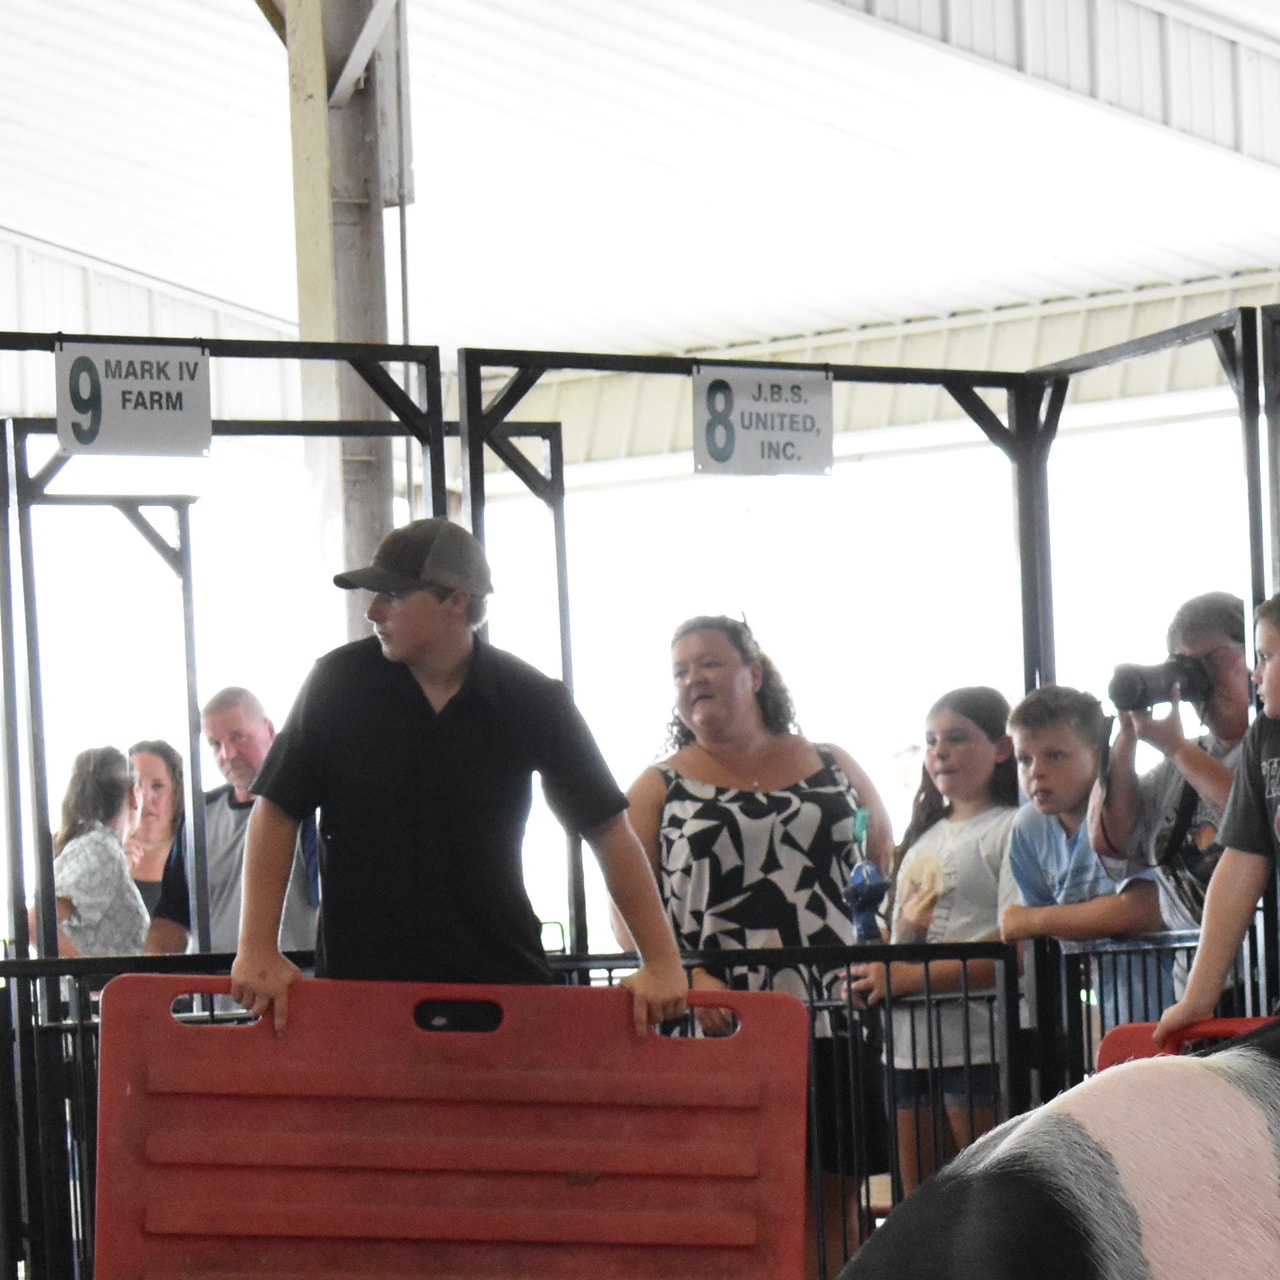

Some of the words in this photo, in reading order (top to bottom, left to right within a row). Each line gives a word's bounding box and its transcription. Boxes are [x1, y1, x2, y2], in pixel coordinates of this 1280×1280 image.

[104, 359, 171, 381] MARK
[178, 361, 199, 381] IV
[69, 356, 102, 445] 9
[121, 390, 184, 411] FARM
[752, 383, 808, 404] J.B.S.
[706, 378, 736, 462] 8
[741, 411, 821, 437] UNITED,
[760, 440, 802, 461] INC.
